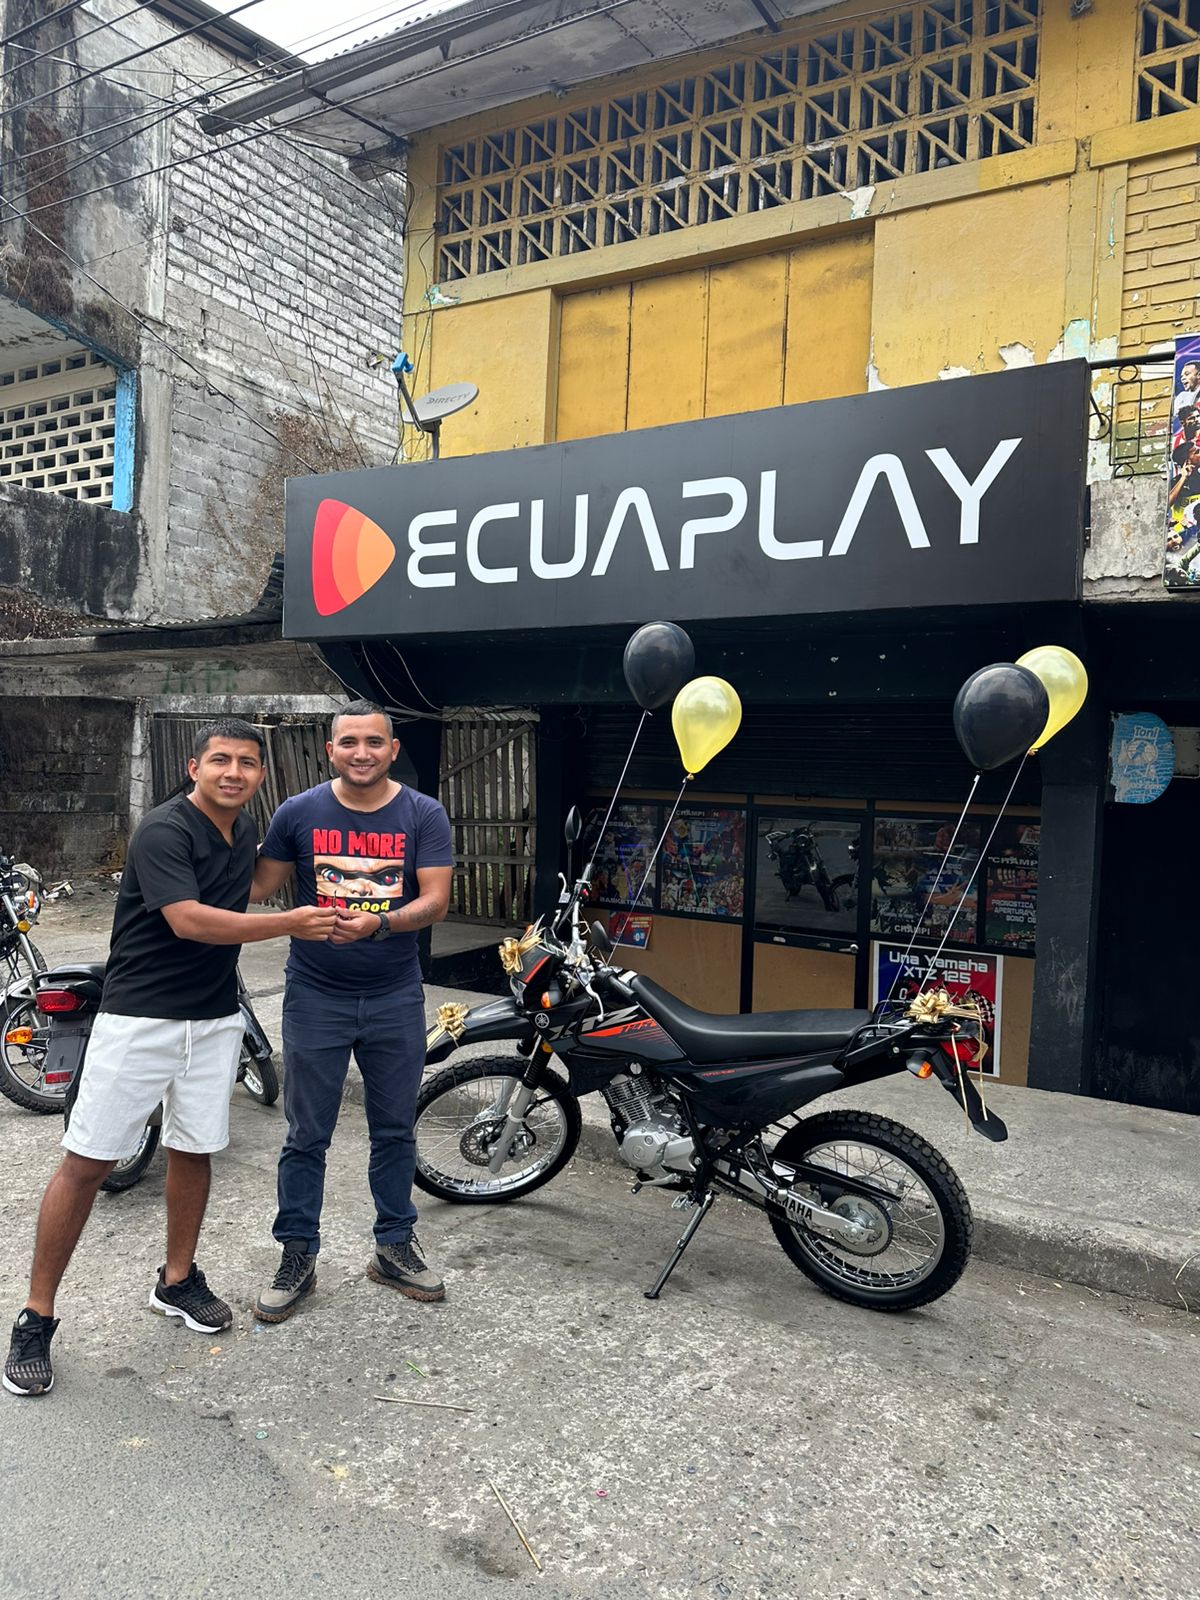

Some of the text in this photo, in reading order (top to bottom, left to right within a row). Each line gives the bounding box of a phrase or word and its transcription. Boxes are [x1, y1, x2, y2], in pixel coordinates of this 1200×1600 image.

[407, 438, 1023, 588] ECUAPLAY
[1134, 726, 1159, 739] Toni
[312, 829, 406, 858] NO MORE
[889, 951, 988, 972] Una Yamaha
[904, 965, 972, 985] XTZ 125
[767, 1190, 813, 1220] MAHA
